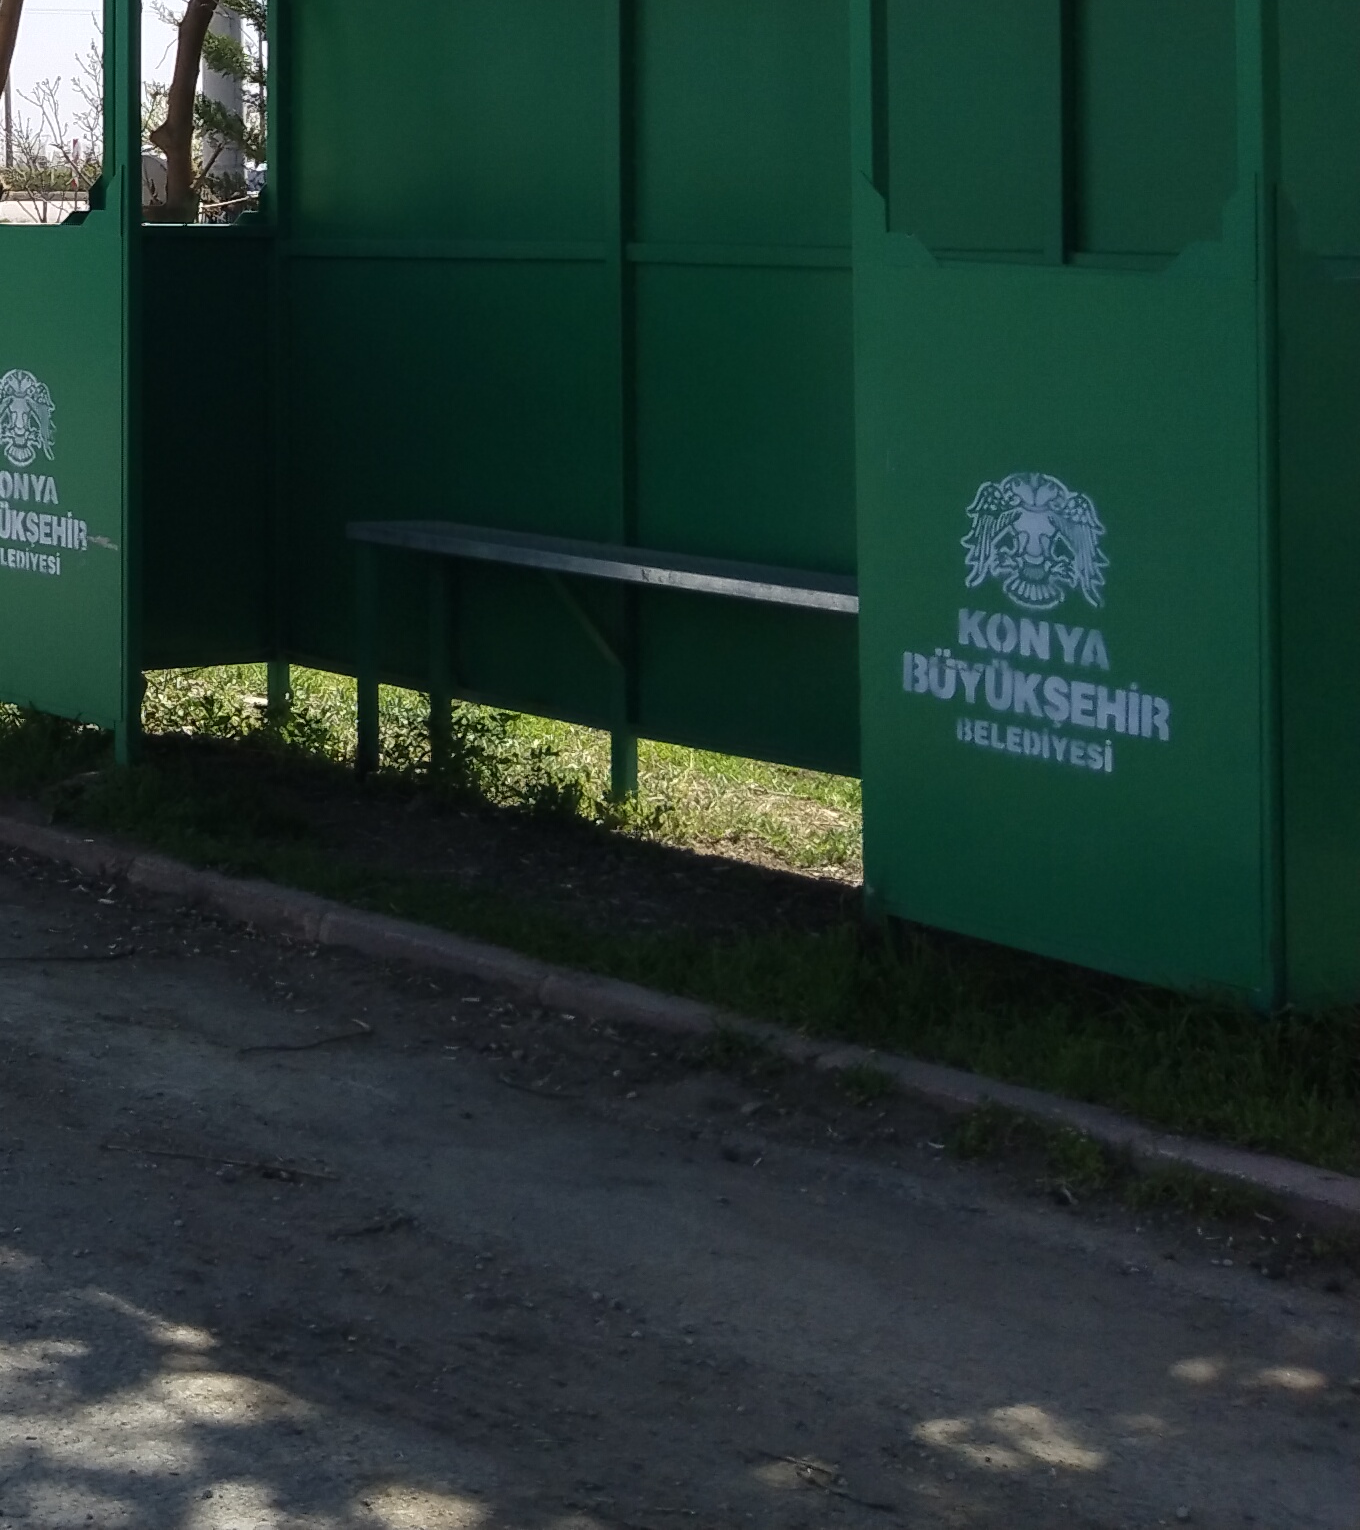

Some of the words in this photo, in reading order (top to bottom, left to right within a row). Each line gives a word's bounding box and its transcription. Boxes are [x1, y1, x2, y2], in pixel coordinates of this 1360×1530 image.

[958, 608, 1110, 670] KONYA
[903, 648, 1169, 740] BÜYÜKŞEHİR
[957, 719, 1112, 773] BELEDİYESİ
